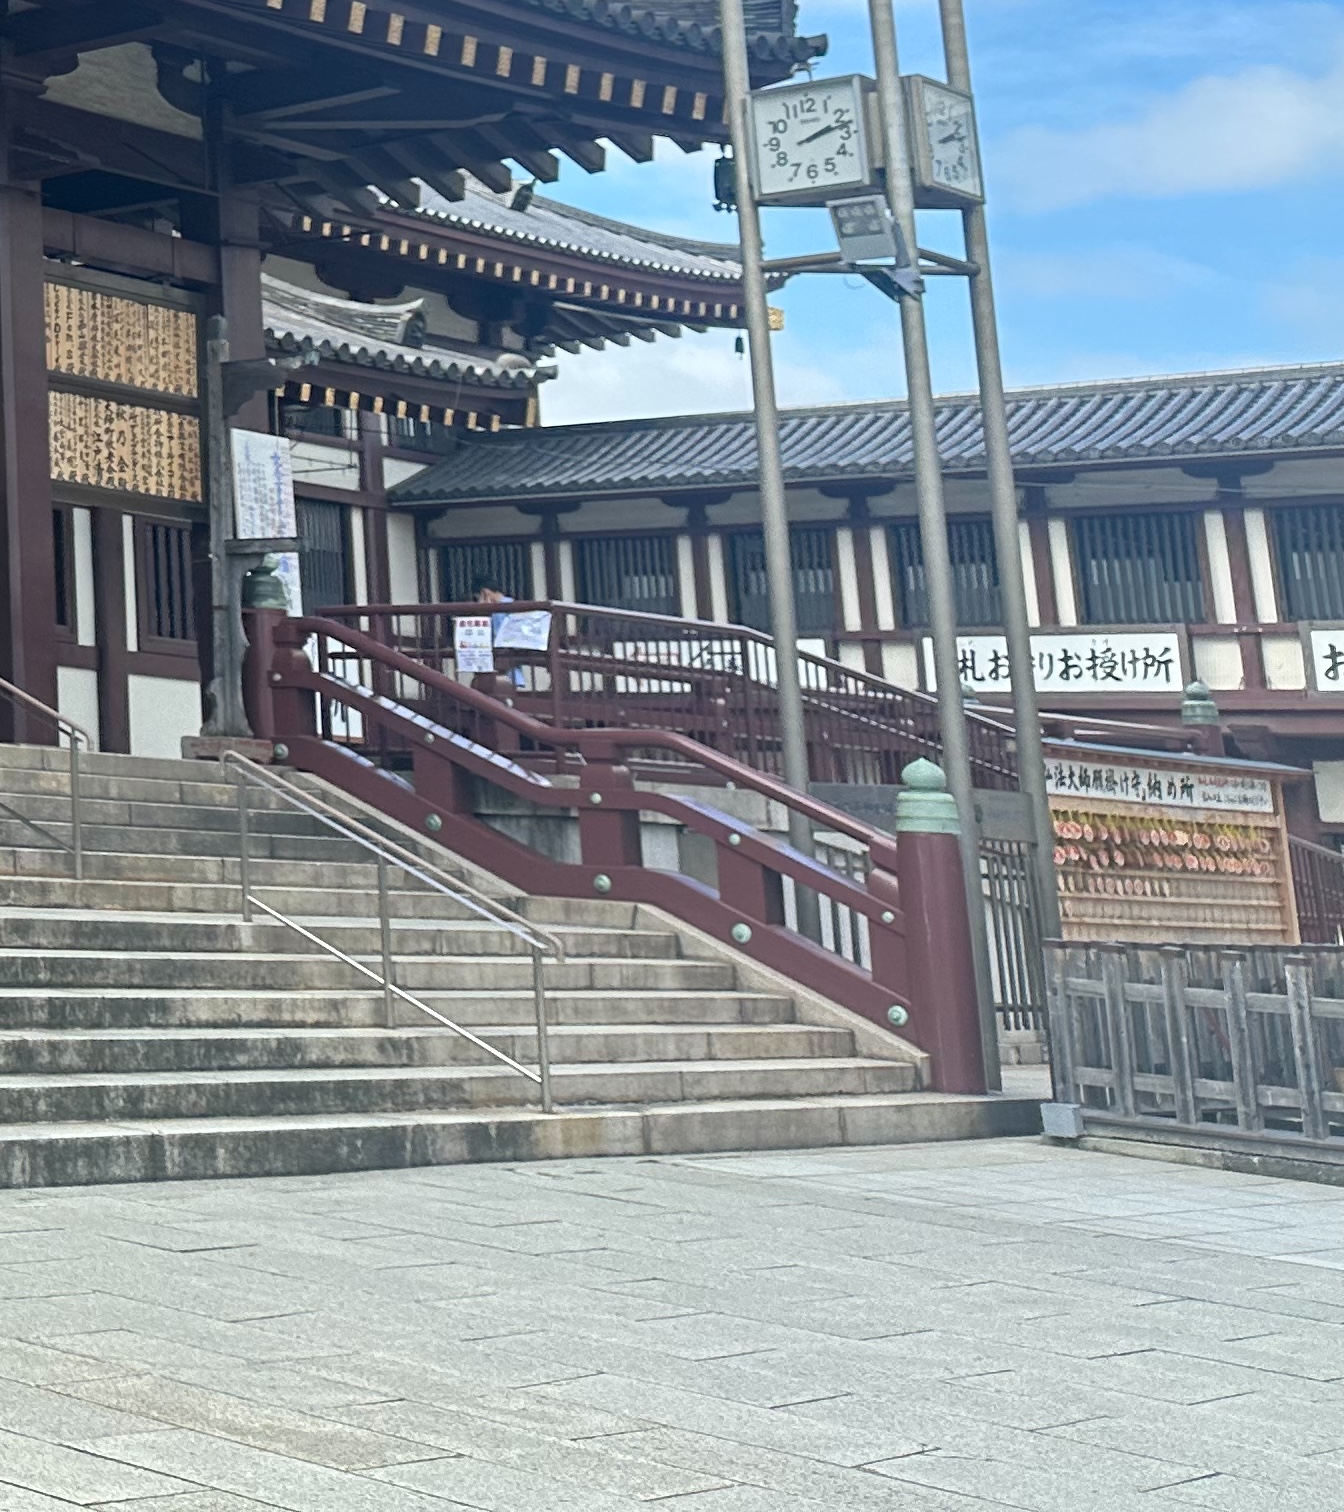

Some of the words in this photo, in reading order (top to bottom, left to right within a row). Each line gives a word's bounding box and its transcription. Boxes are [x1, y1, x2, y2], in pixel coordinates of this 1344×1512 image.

[782, 102, 798, 119] 11
[799, 97, 817, 113] 12
[833, 108, 845, 124] 2
[767, 119, 788, 134] 10
[839, 124, 852, 141] 3
[768, 137, 781, 152] 9
[836, 142, 848, 156] 4
[776, 151, 789, 167] 8
[824, 157, 836, 172] 5
[790, 162, 802, 177] 7
[806, 164, 819, 179] 6
[958, 645, 1176, 684] 札おりお授け所
